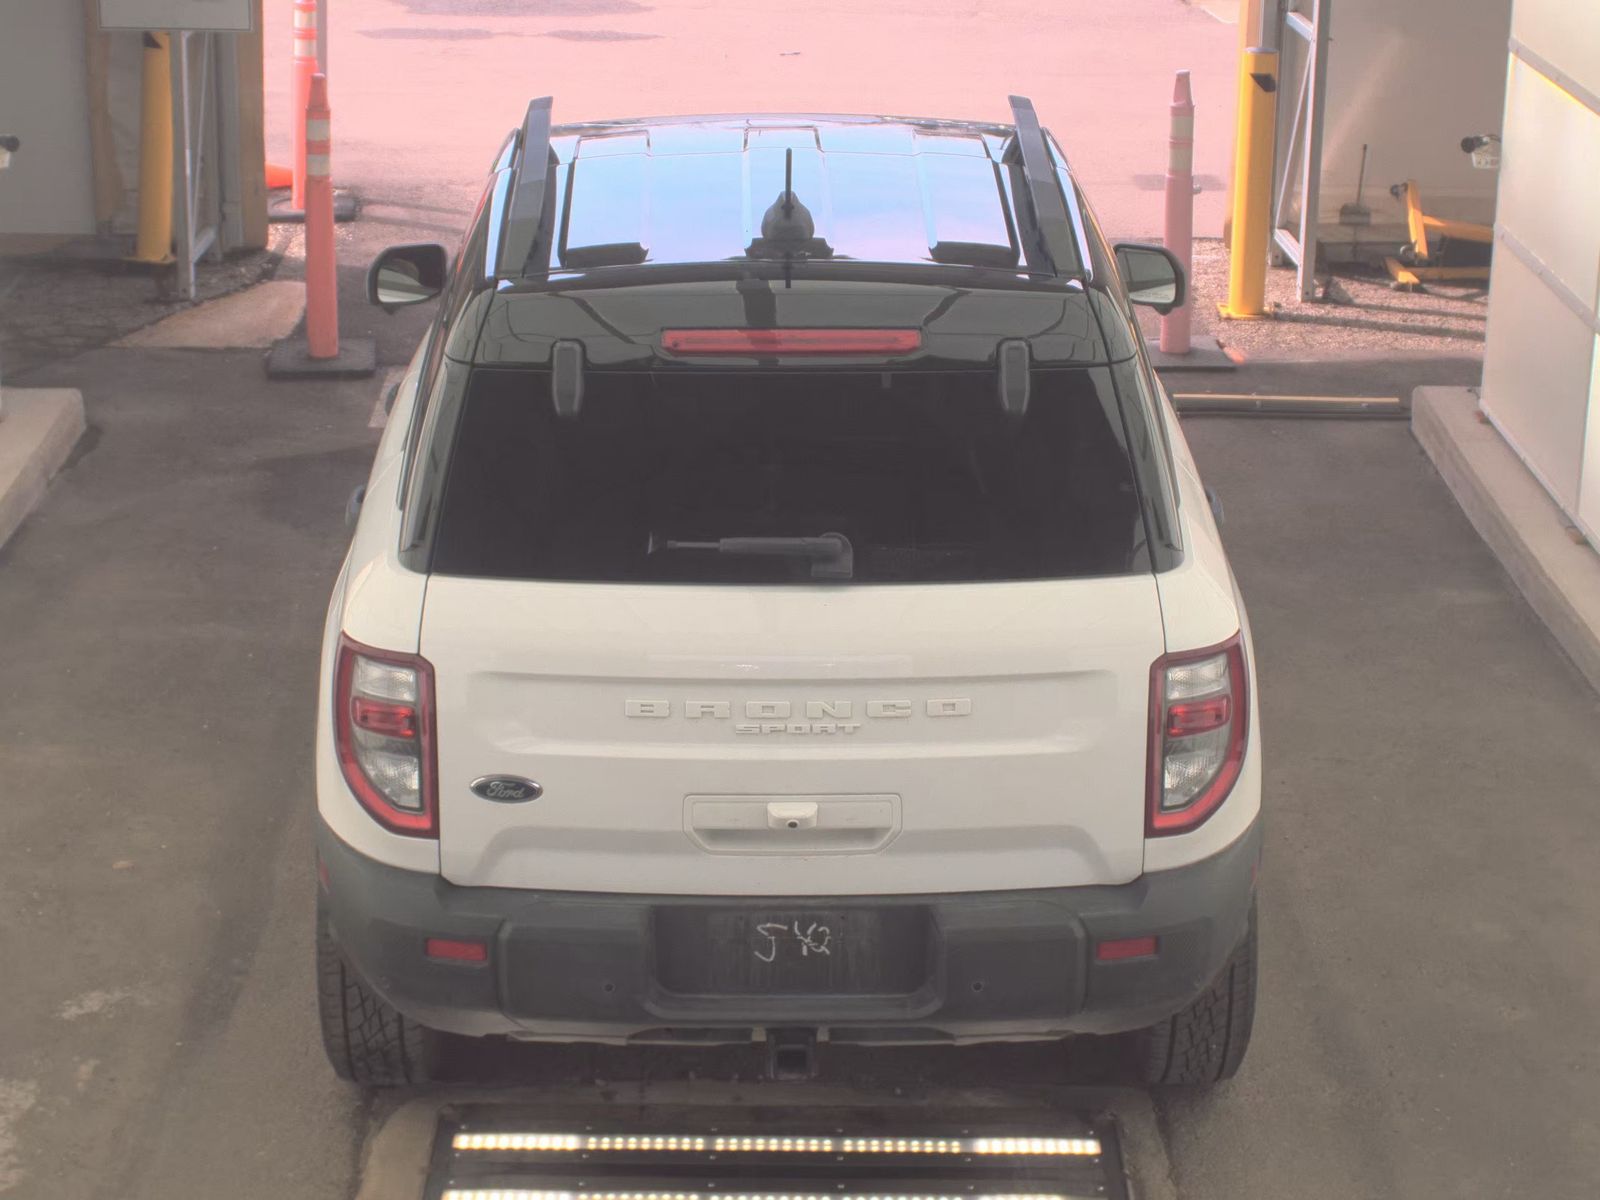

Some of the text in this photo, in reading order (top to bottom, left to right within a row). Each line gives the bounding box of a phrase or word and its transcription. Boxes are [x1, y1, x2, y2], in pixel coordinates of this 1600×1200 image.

[625, 699, 972, 719] BRONCO
[735, 723, 861, 735] SPORT
[485, 781, 525, 799] Ford
